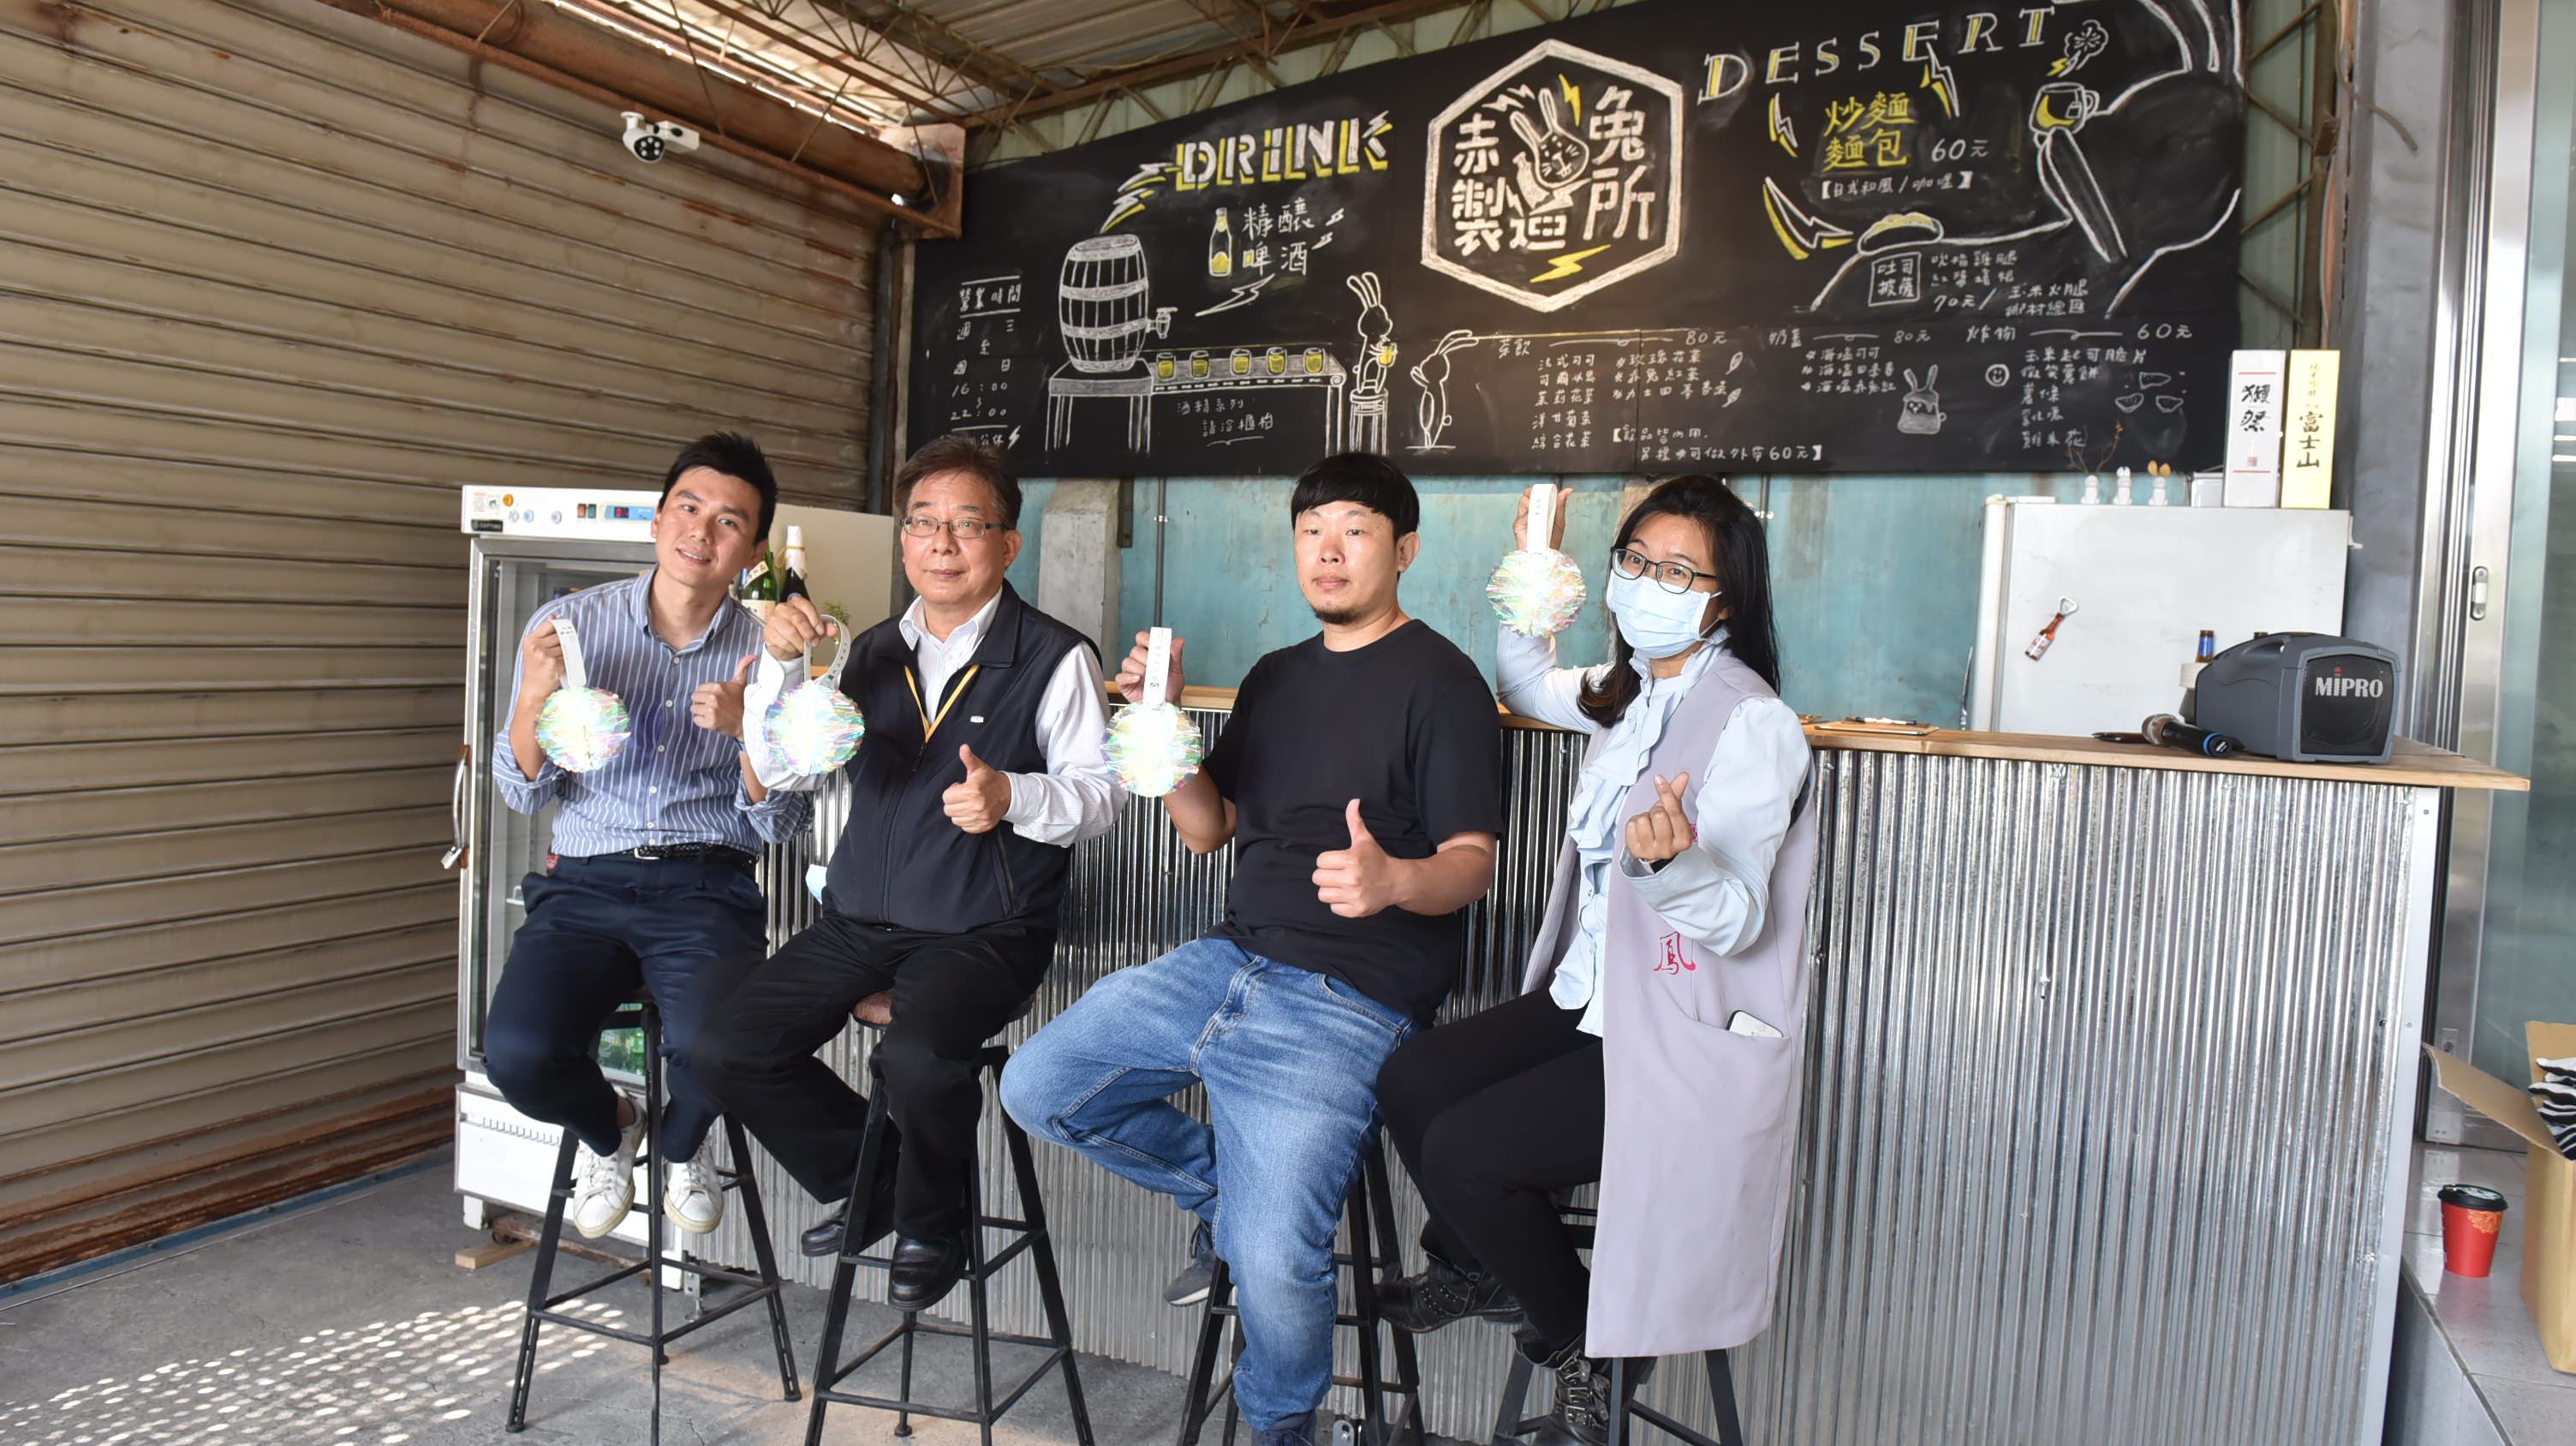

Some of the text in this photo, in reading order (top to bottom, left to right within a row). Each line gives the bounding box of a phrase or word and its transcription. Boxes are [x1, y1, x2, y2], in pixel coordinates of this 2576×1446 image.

[1698, 7, 2054, 105] DESSERT
[1824, 91, 1918, 135] 炒麵
[1175, 112, 1392, 190] DRINK
[1822, 128, 1908, 171] 麵包
[1931, 138, 1989, 163] 60元
[1242, 198, 1315, 240] 精釀
[1452, 165, 1656, 257] 製造所
[1242, 242, 1309, 276] 啤酒
[1685, 331, 1727, 346] 80元
[1893, 330, 1931, 344] 80元
[2138, 324, 2193, 339] 60元
[2296, 410, 2323, 468] 富士山
